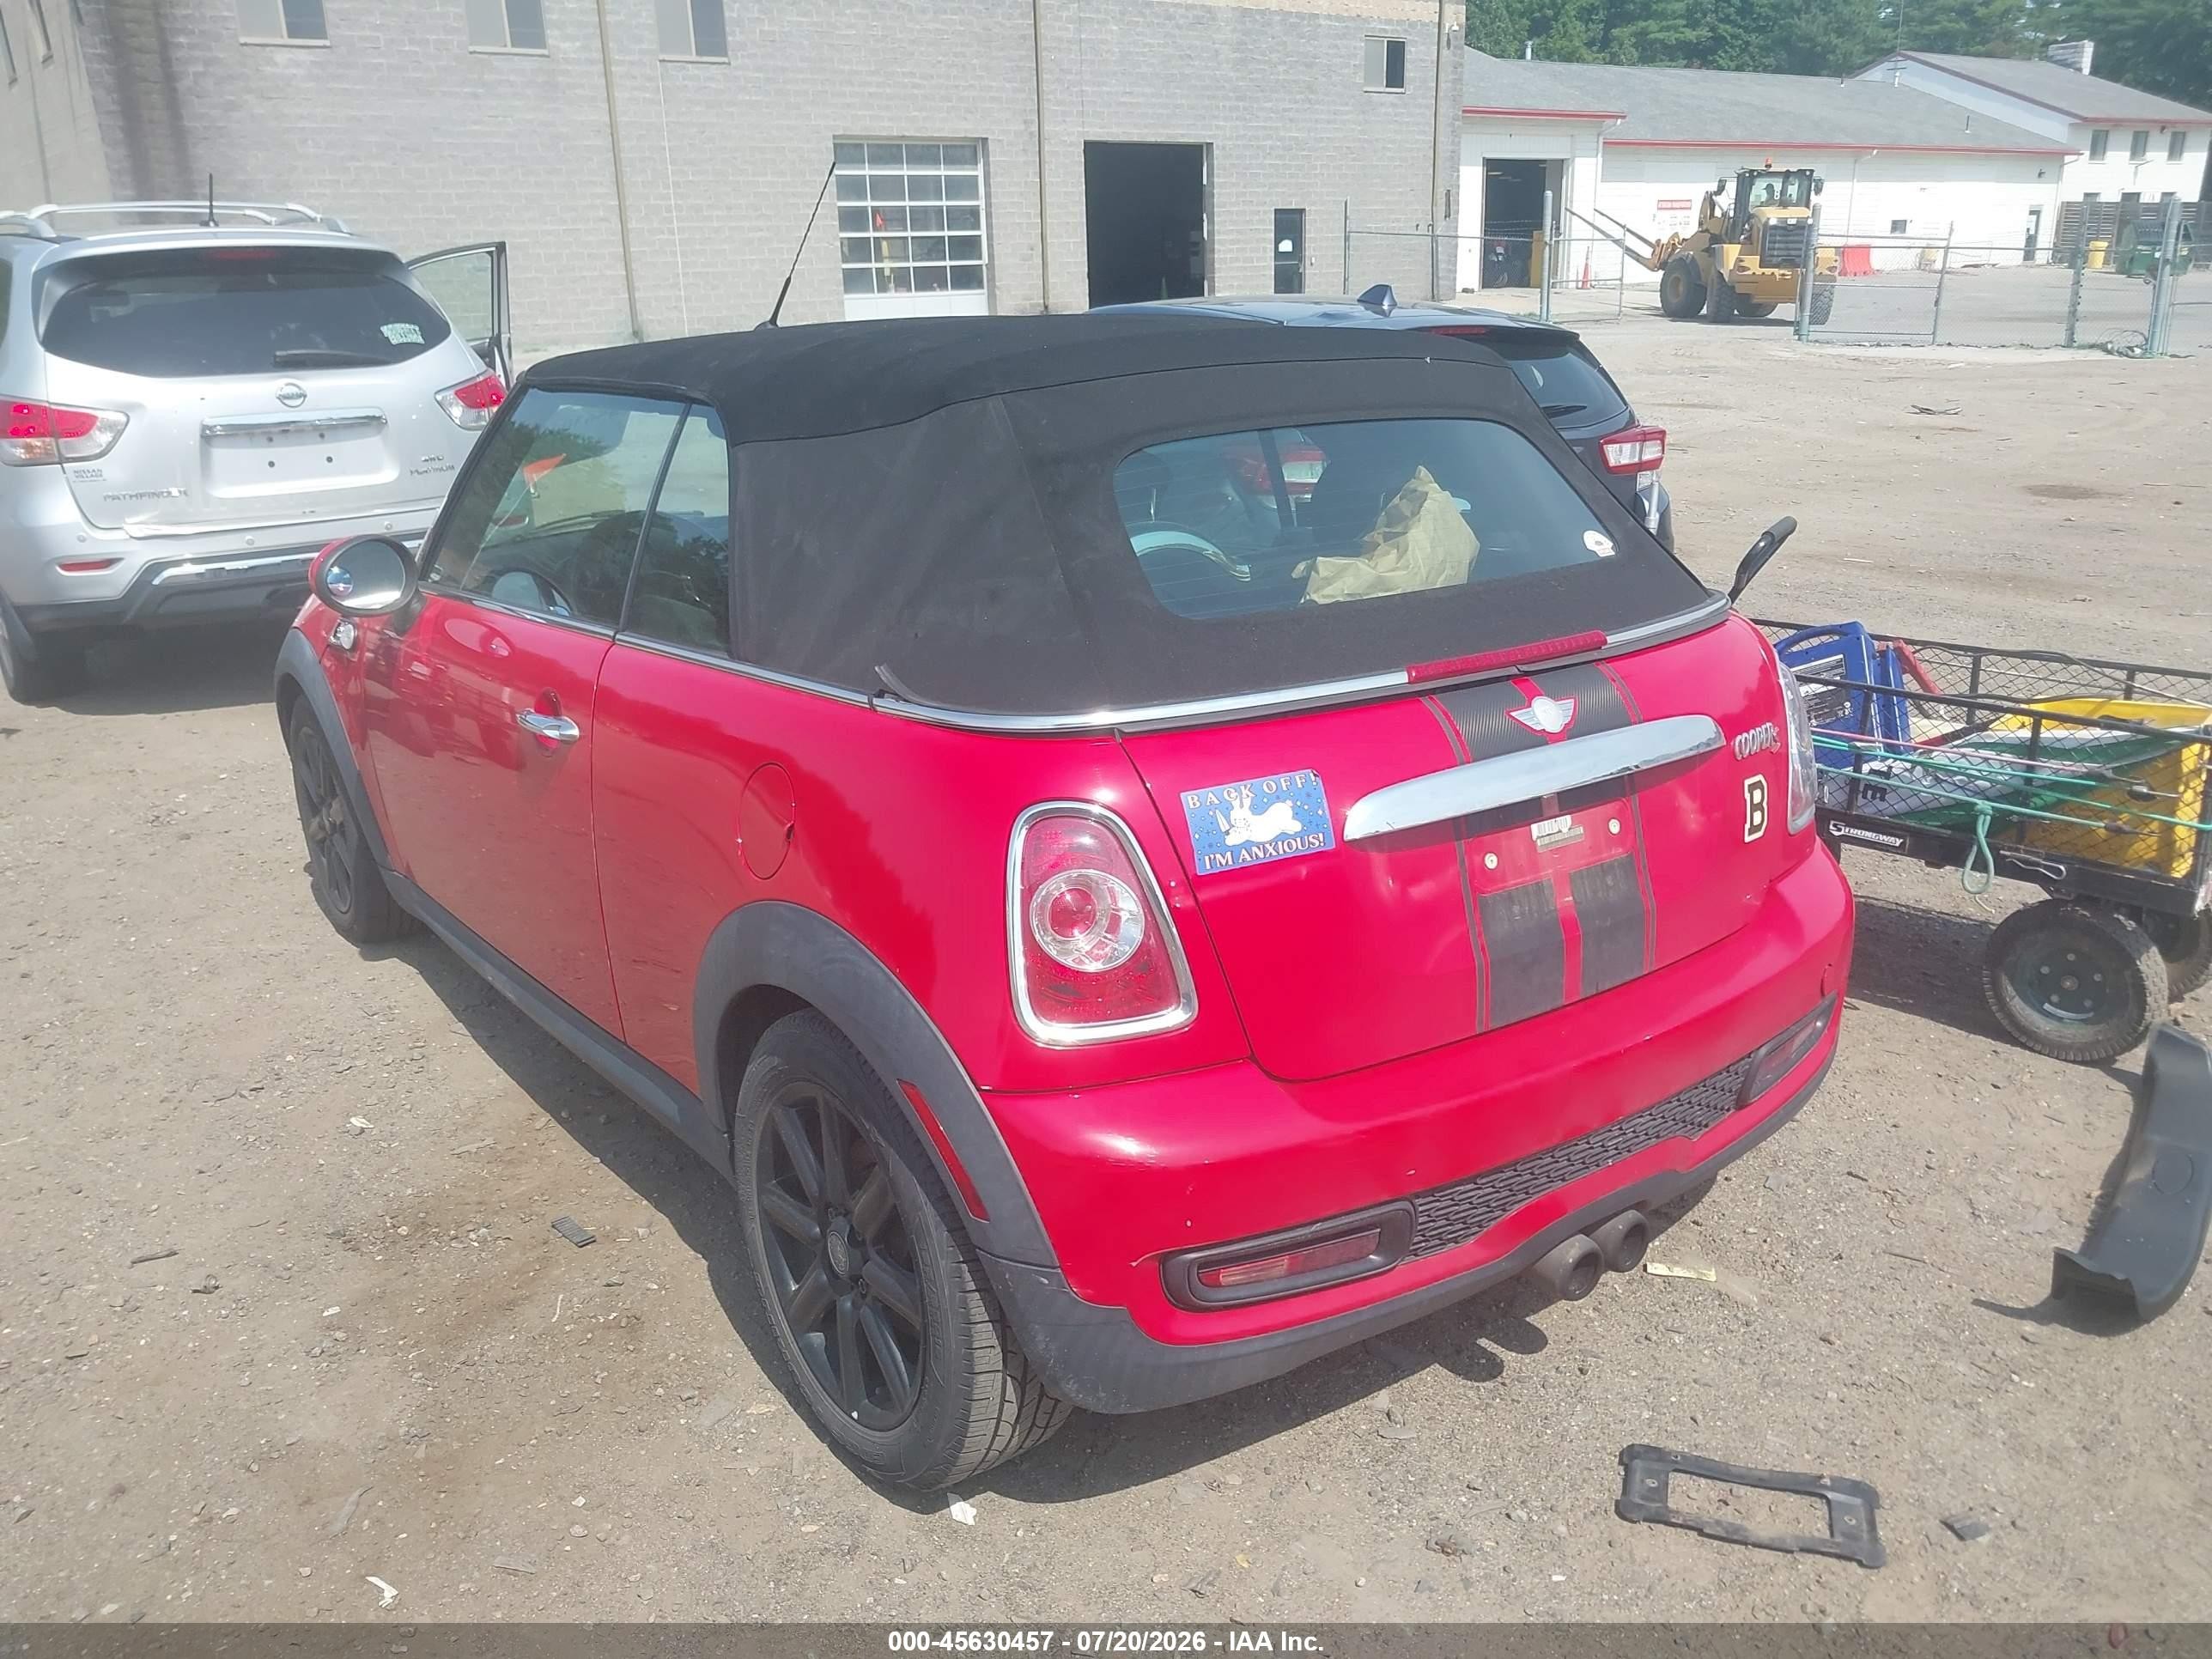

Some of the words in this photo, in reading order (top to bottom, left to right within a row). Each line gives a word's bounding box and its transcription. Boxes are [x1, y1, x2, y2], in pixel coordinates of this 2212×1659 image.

[1734, 722, 1775, 761] COOPER
[1187, 783, 1255, 809] BACK
[1262, 773, 1320, 794] OFF!
[1744, 774, 1767, 843] B
[1204, 851, 1234, 870] I'M
[1238, 832, 1325, 863] ANXIOUS!
[1829, 820, 1904, 847] STRONGWAY
